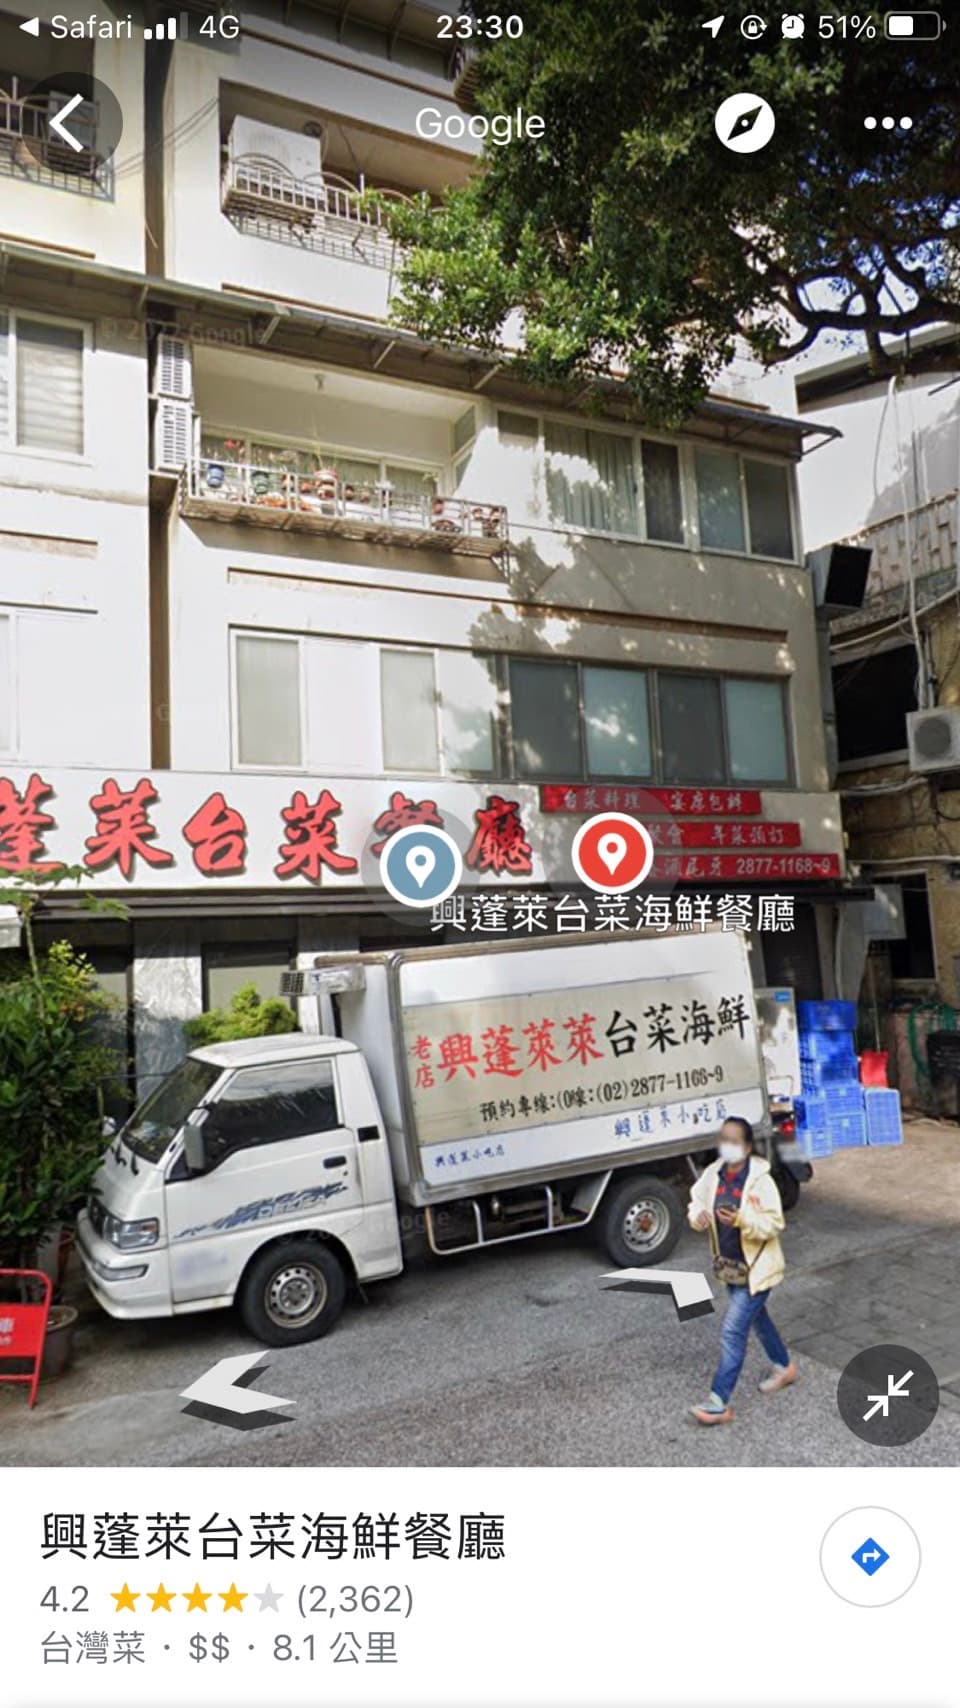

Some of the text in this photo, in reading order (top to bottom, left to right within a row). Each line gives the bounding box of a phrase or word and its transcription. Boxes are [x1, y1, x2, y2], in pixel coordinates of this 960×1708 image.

[564, 789, 640, 810] 台菜料理
[736, 858, 831, 874] 2877-1168~9
[411, 1034, 435, 1089] 老店
